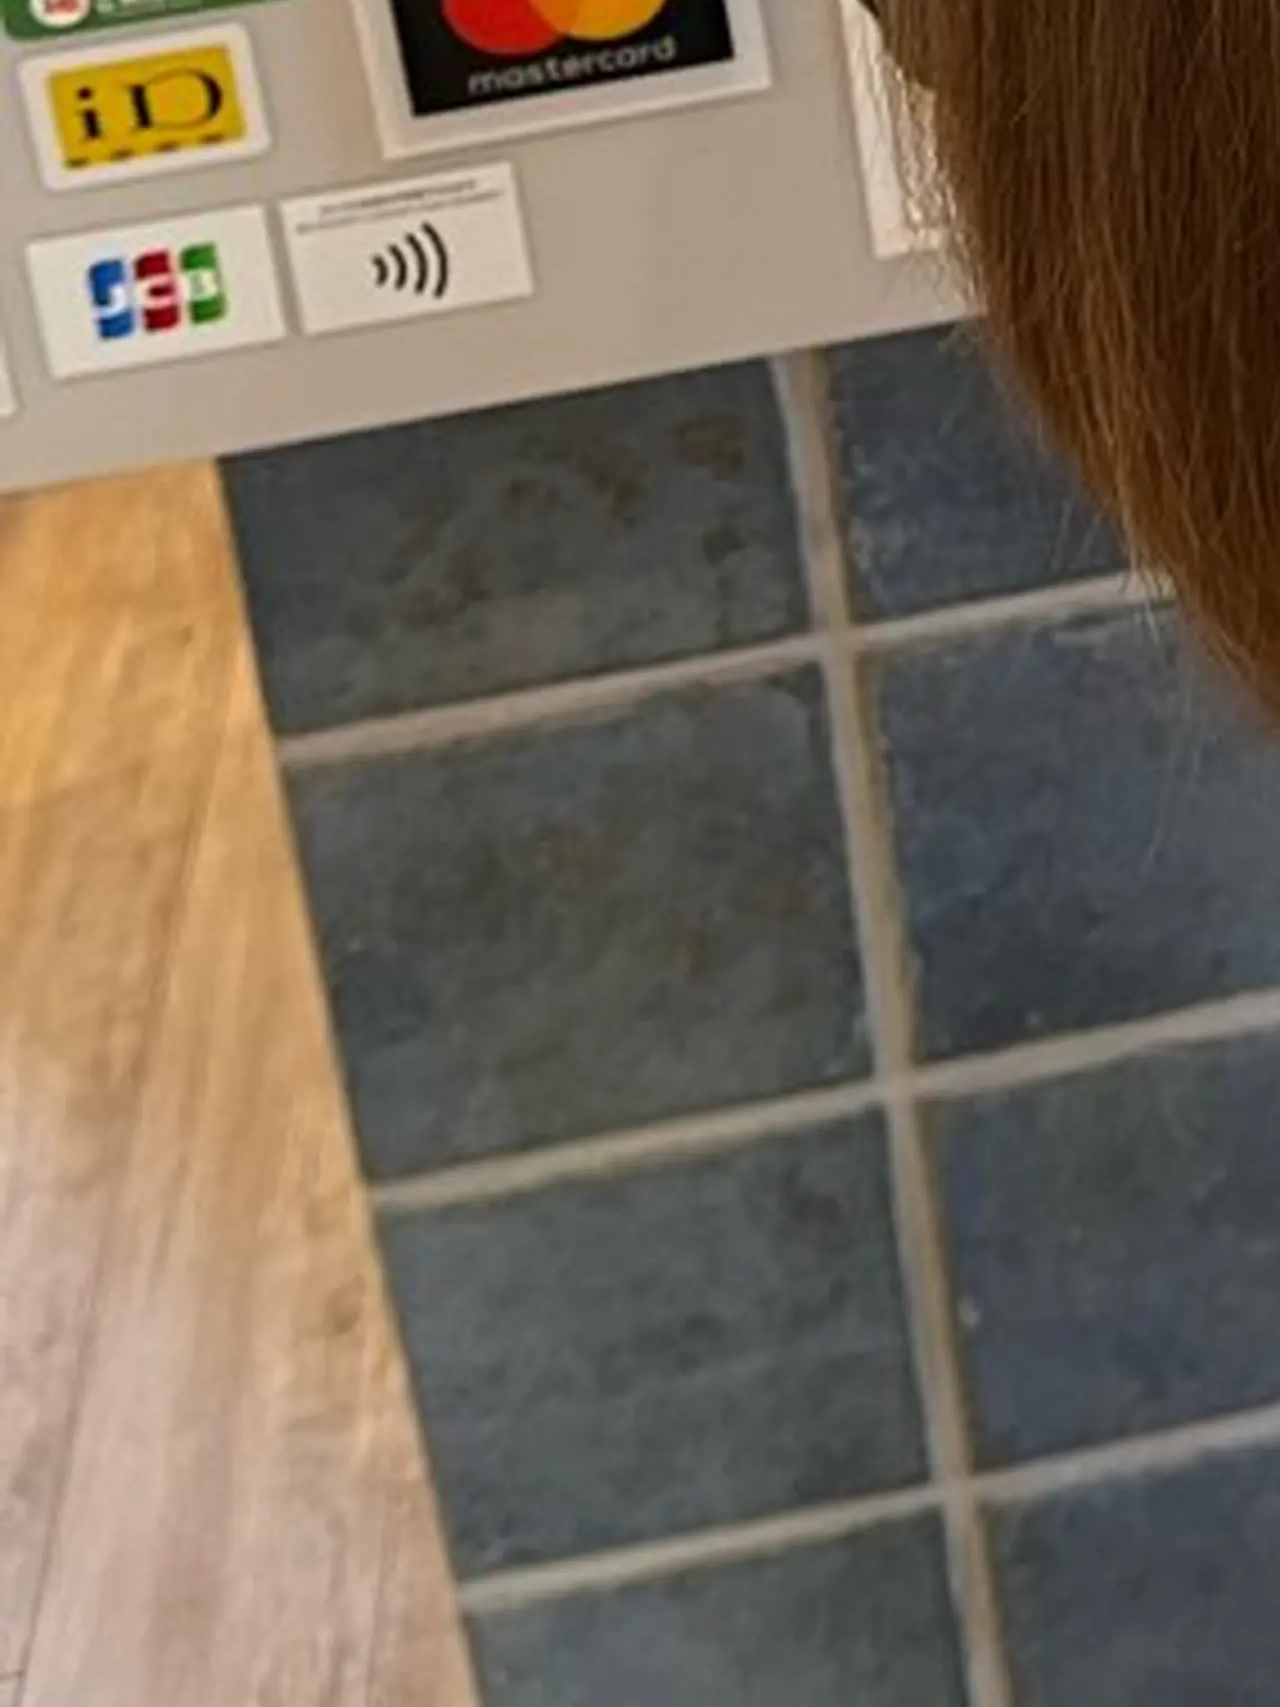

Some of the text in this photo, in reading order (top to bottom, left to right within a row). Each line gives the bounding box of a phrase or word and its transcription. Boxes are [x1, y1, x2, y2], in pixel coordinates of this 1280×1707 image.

[468, 37, 677, 95] mastercard
[76, 68, 222, 140] iD
[88, 242, 227, 341] JCB
